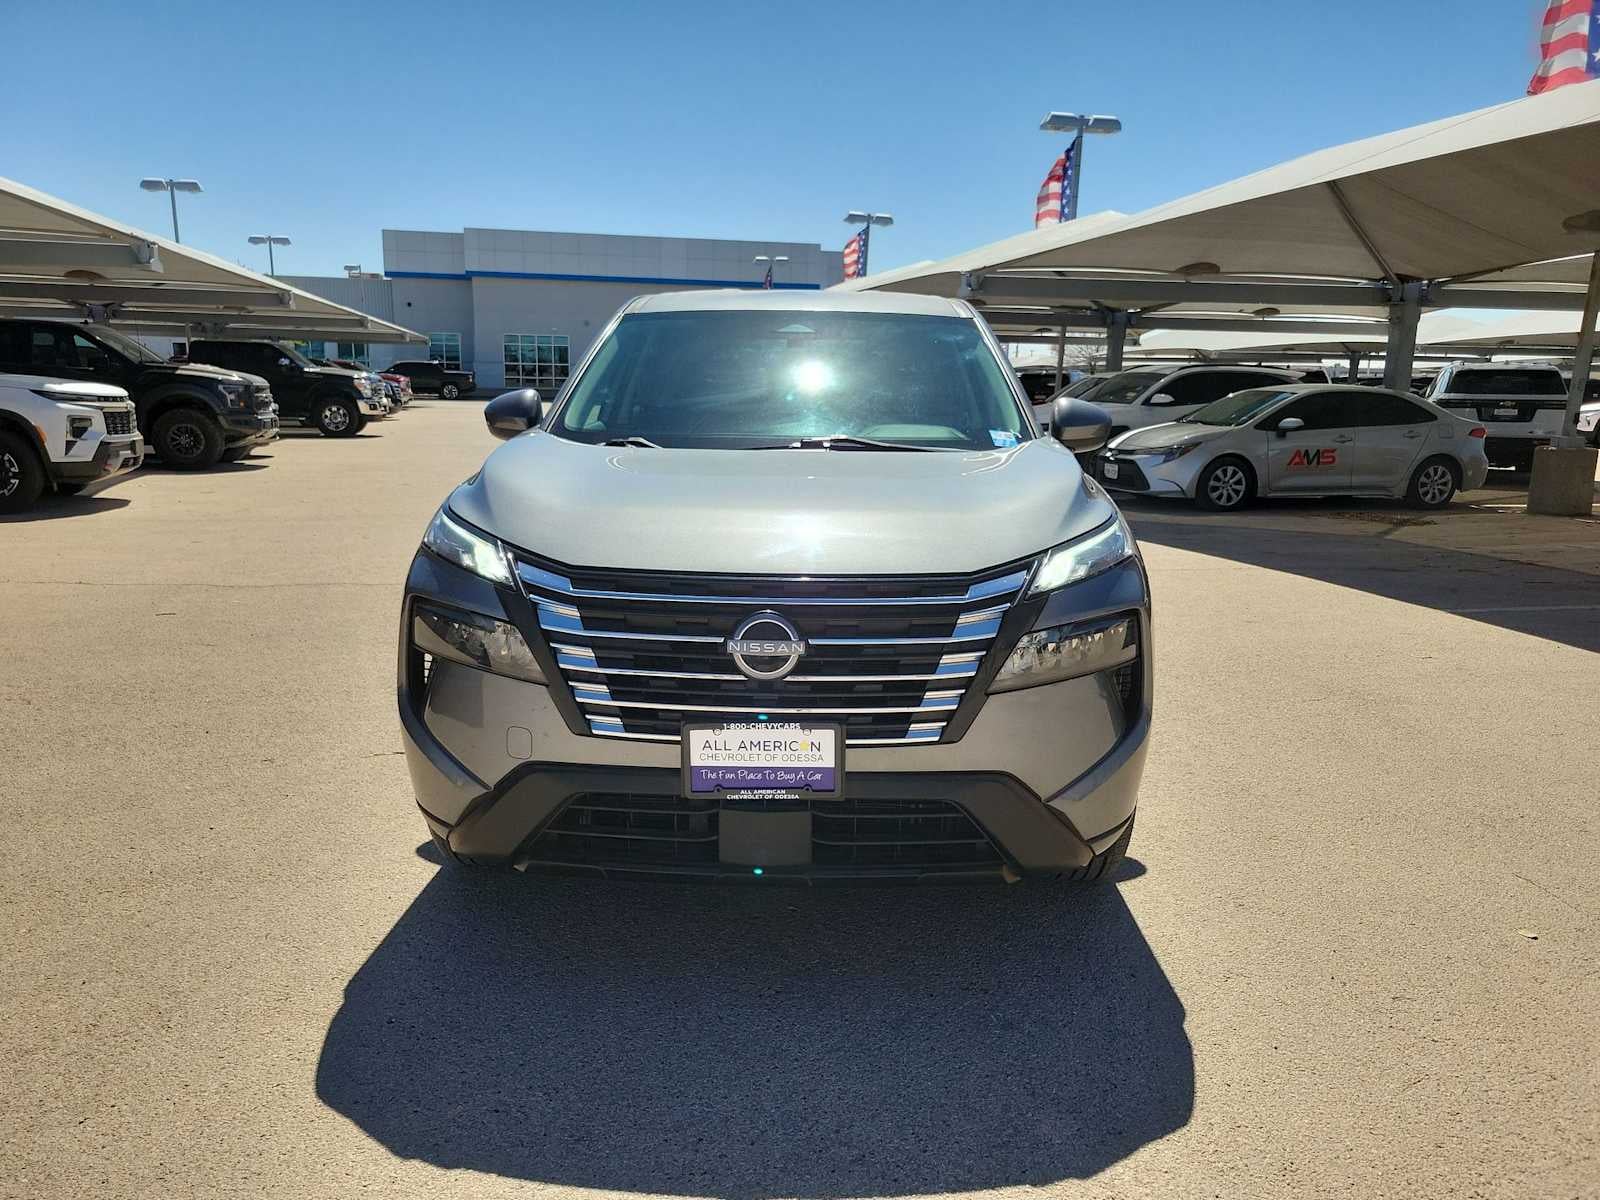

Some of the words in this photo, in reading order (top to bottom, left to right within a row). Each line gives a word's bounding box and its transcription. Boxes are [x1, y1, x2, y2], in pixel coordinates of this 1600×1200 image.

[1287, 448, 1337, 465] AMS
[729, 641, 803, 653] NISSAN
[722, 722, 801, 730] 1-800-CHEVYCARS
[702, 739, 732, 751] ALL
[737, 739, 821, 752] AMERICN
[699, 752, 761, 761] CHEVROLET
[764, 753, 779, 762] OF
[781, 753, 824, 762] ODESSA
[700, 769, 717, 780] The
[737, 769, 763, 780] Place
[763, 769, 776, 780] To
[777, 770, 796, 784] Buy
[796, 770, 806, 781] A
[806, 770, 823, 781] Car
